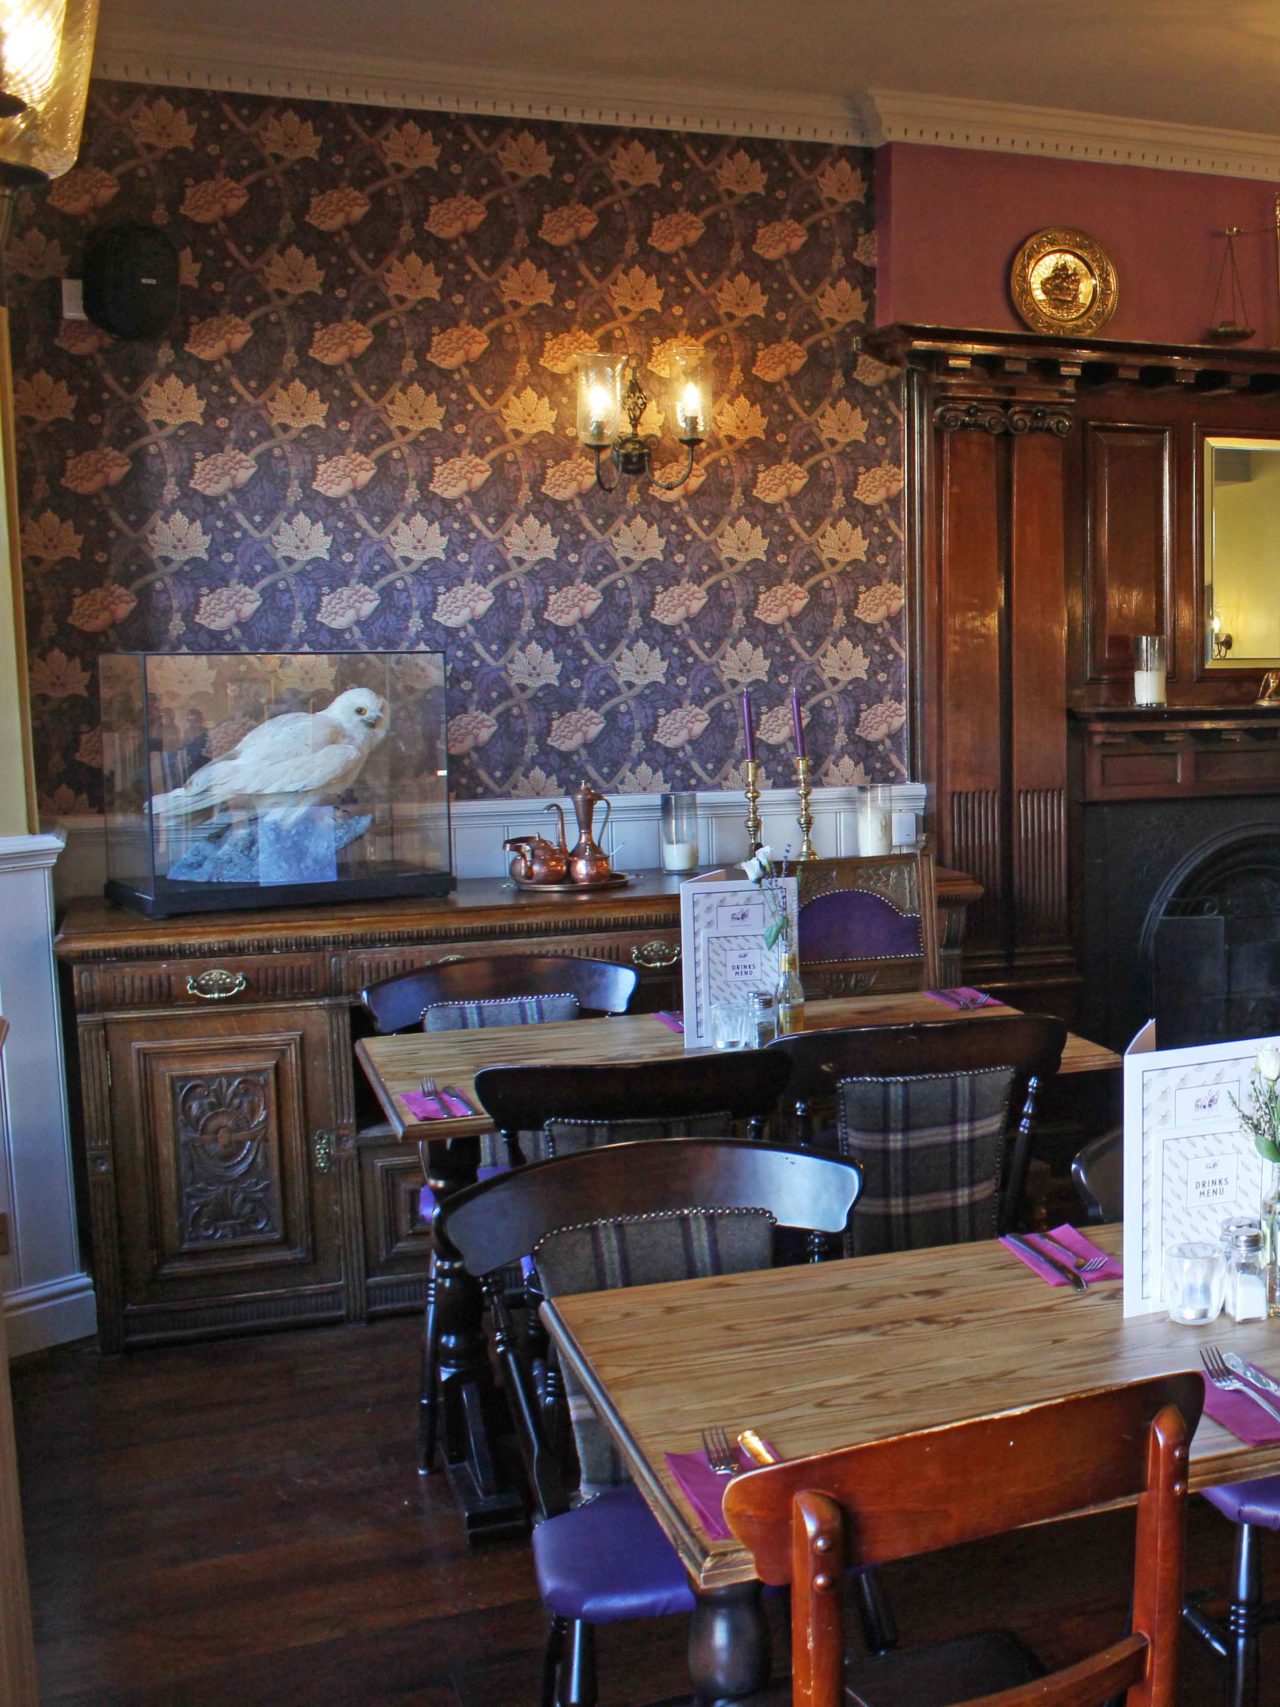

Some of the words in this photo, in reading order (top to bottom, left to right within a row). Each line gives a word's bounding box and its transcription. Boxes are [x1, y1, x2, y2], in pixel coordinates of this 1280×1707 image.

[731, 963, 756, 971] DRINKS
[1195, 1177, 1229, 1190] DRINKS
[1199, 1187, 1224, 1198] MENU
